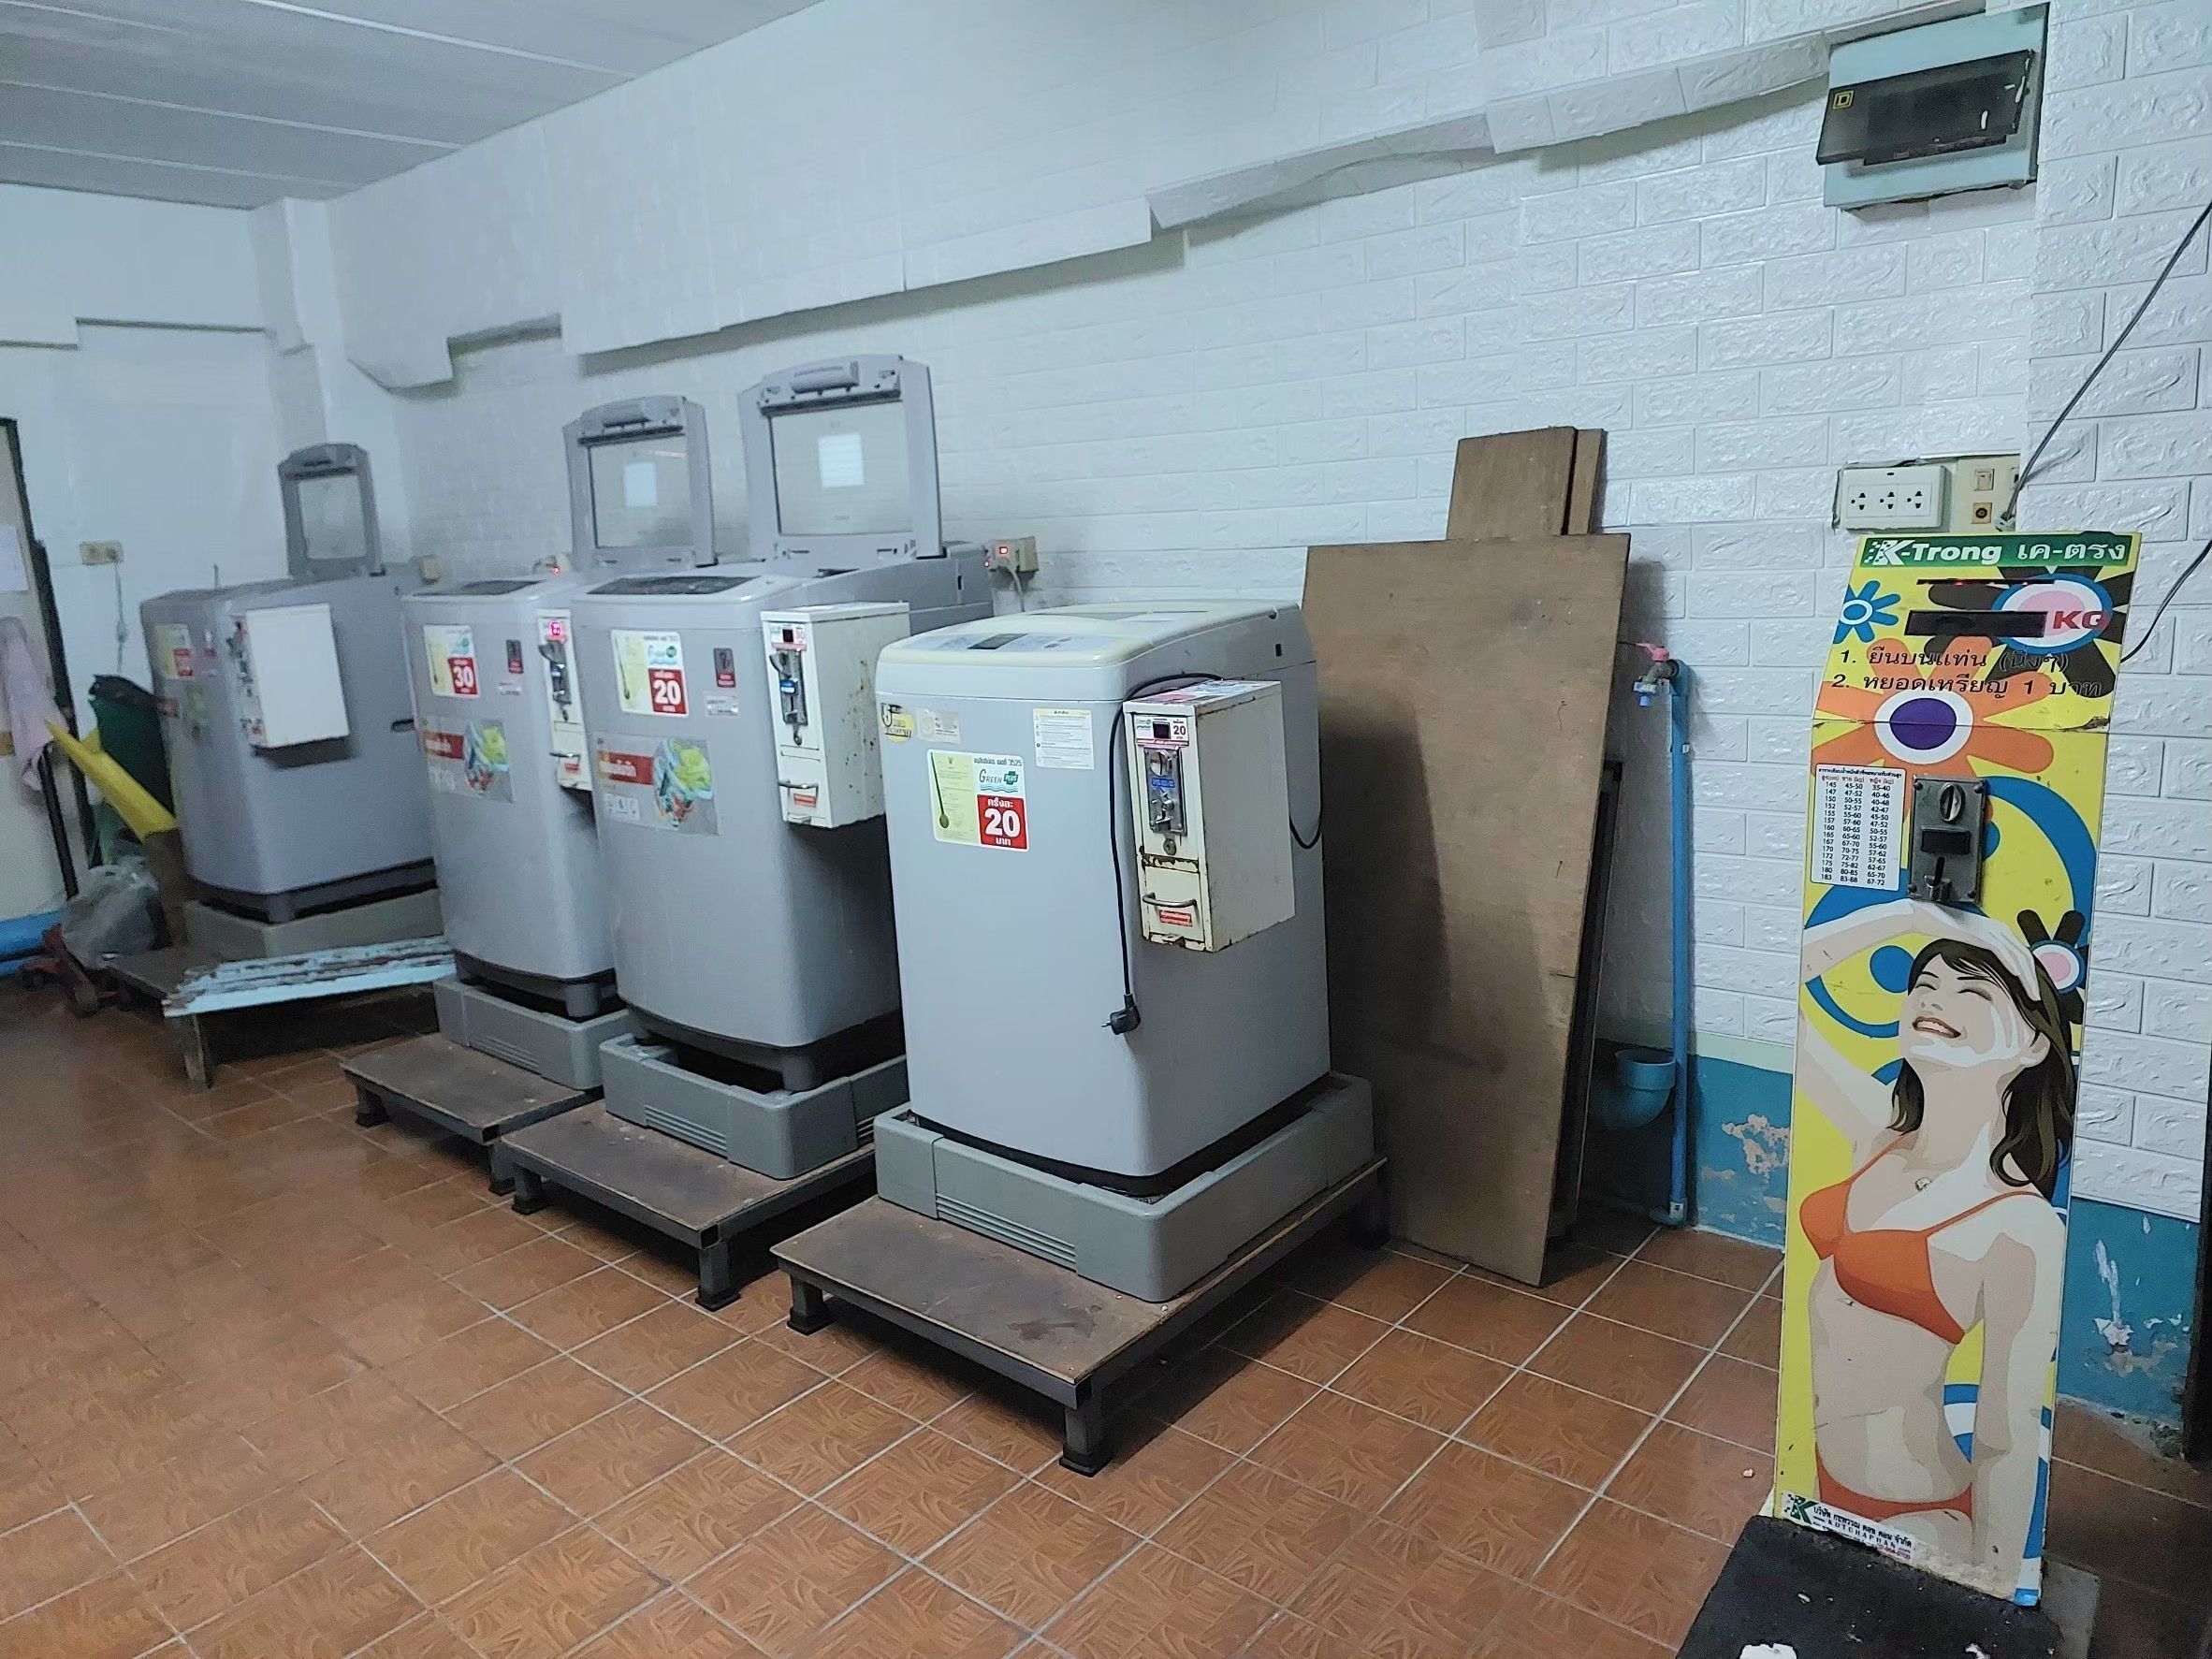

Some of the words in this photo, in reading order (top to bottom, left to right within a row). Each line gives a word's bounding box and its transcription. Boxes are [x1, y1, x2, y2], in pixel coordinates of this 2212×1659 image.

[1868, 539, 2002, 566] K-Trong
[2017, 541, 2125, 561] เค-ตรง
[2053, 610, 2104, 630] KG
[1841, 649, 1856, 663] 1.
[1869, 646, 1986, 667] ยืนบนแท่น
[453, 665, 474, 689] 30
[1831, 674, 1850, 688] 2.
[1863, 673, 2008, 699] หยอดเหรียญ
[2023, 680, 2034, 695] 1
[2049, 681, 2103, 696] บาท
[653, 679, 681, 706] 20
[1172, 725, 1186, 735] 20
[984, 808, 1021, 838] 20
[996, 837, 1011, 846] บาท
